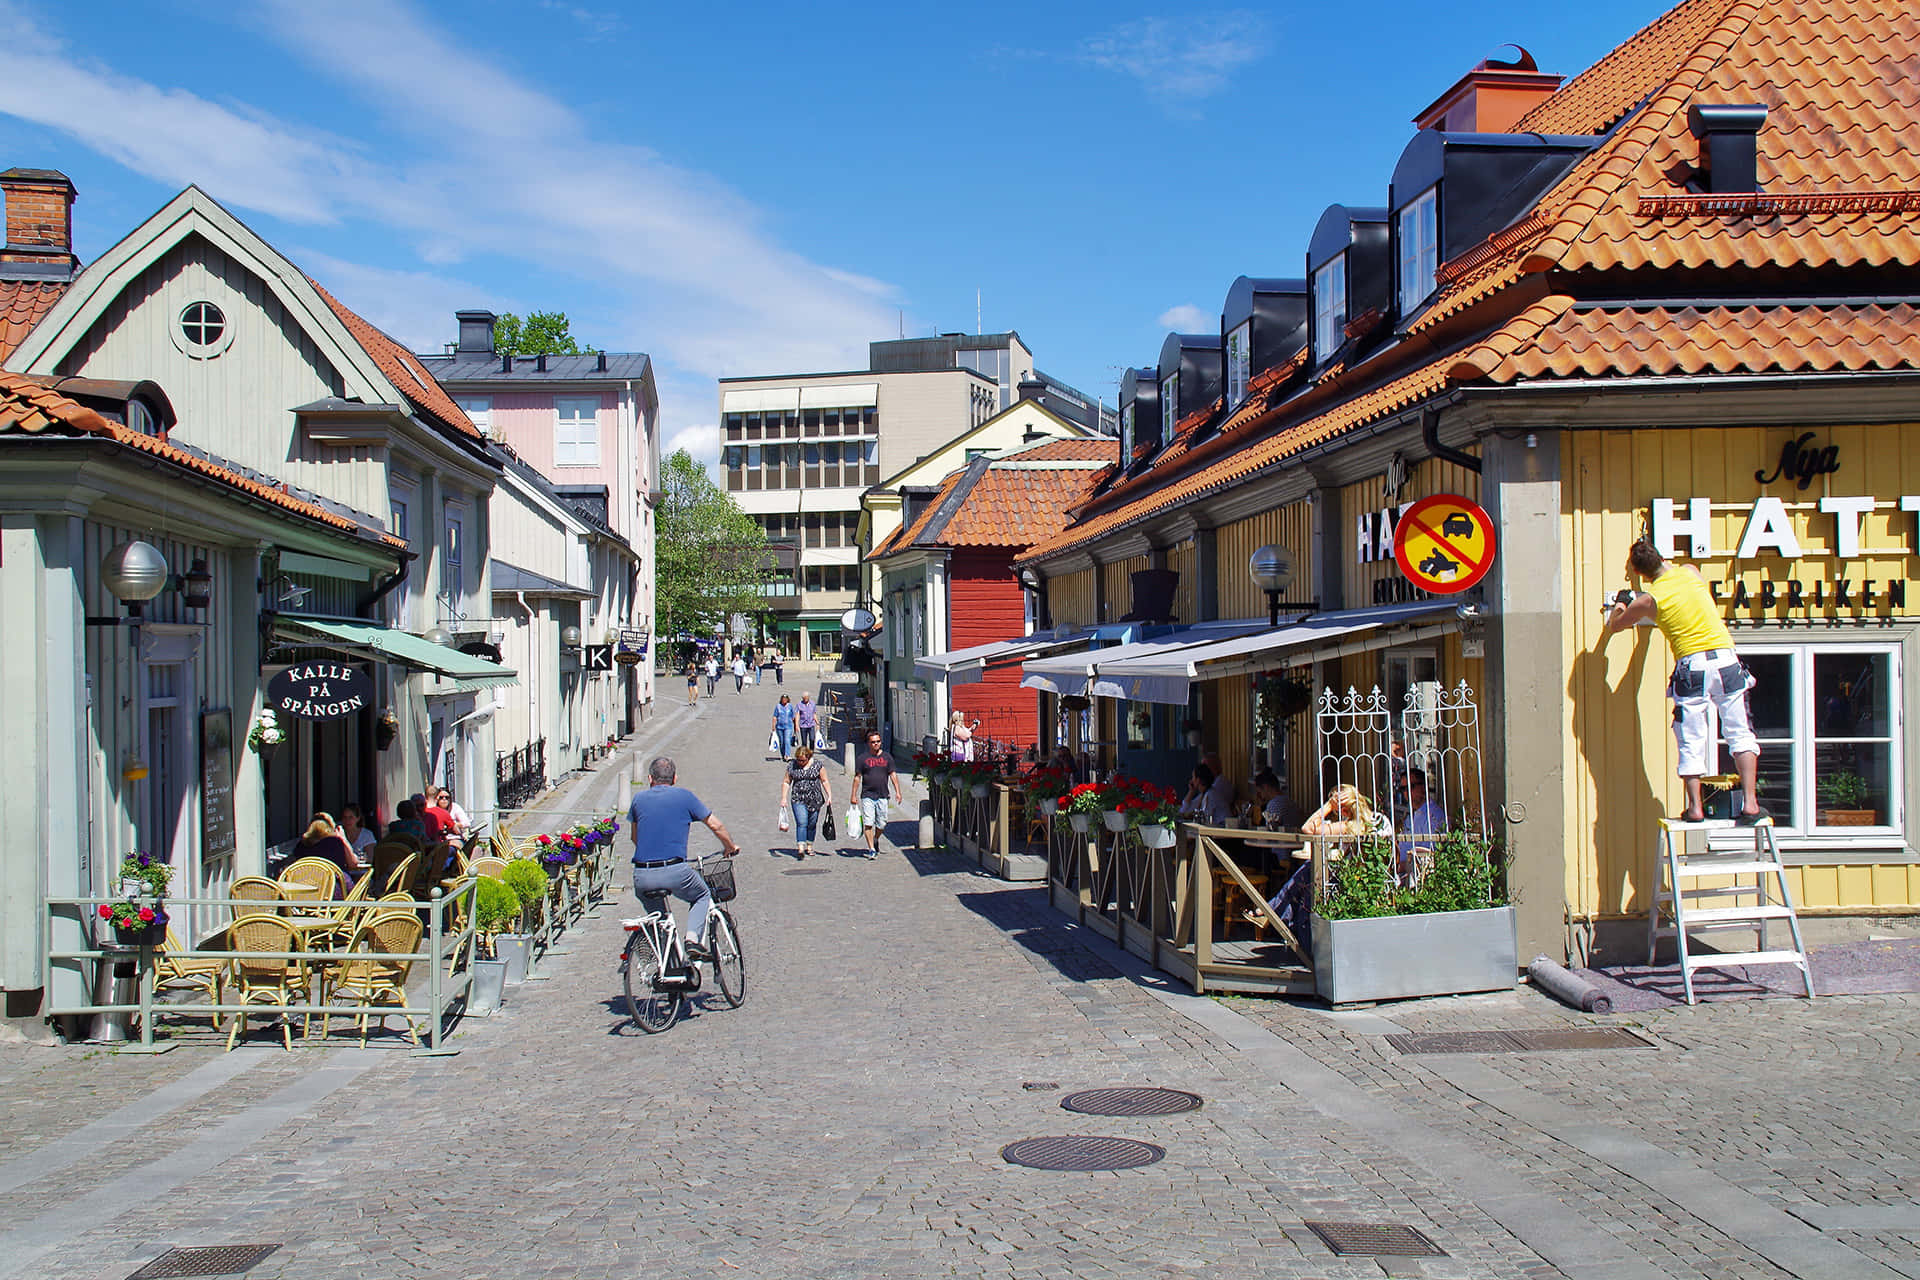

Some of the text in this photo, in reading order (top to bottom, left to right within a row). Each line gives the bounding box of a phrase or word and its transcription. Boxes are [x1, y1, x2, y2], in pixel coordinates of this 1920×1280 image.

[1755, 432, 1840, 490] Nya
[1710, 580, 1905, 609] FABRIKEN
[591, 647, 608, 668] K
[288, 664, 352, 682] KALLE
[309, 682, 331, 697] PÅ
[281, 695, 363, 716] SPÅNGEN
